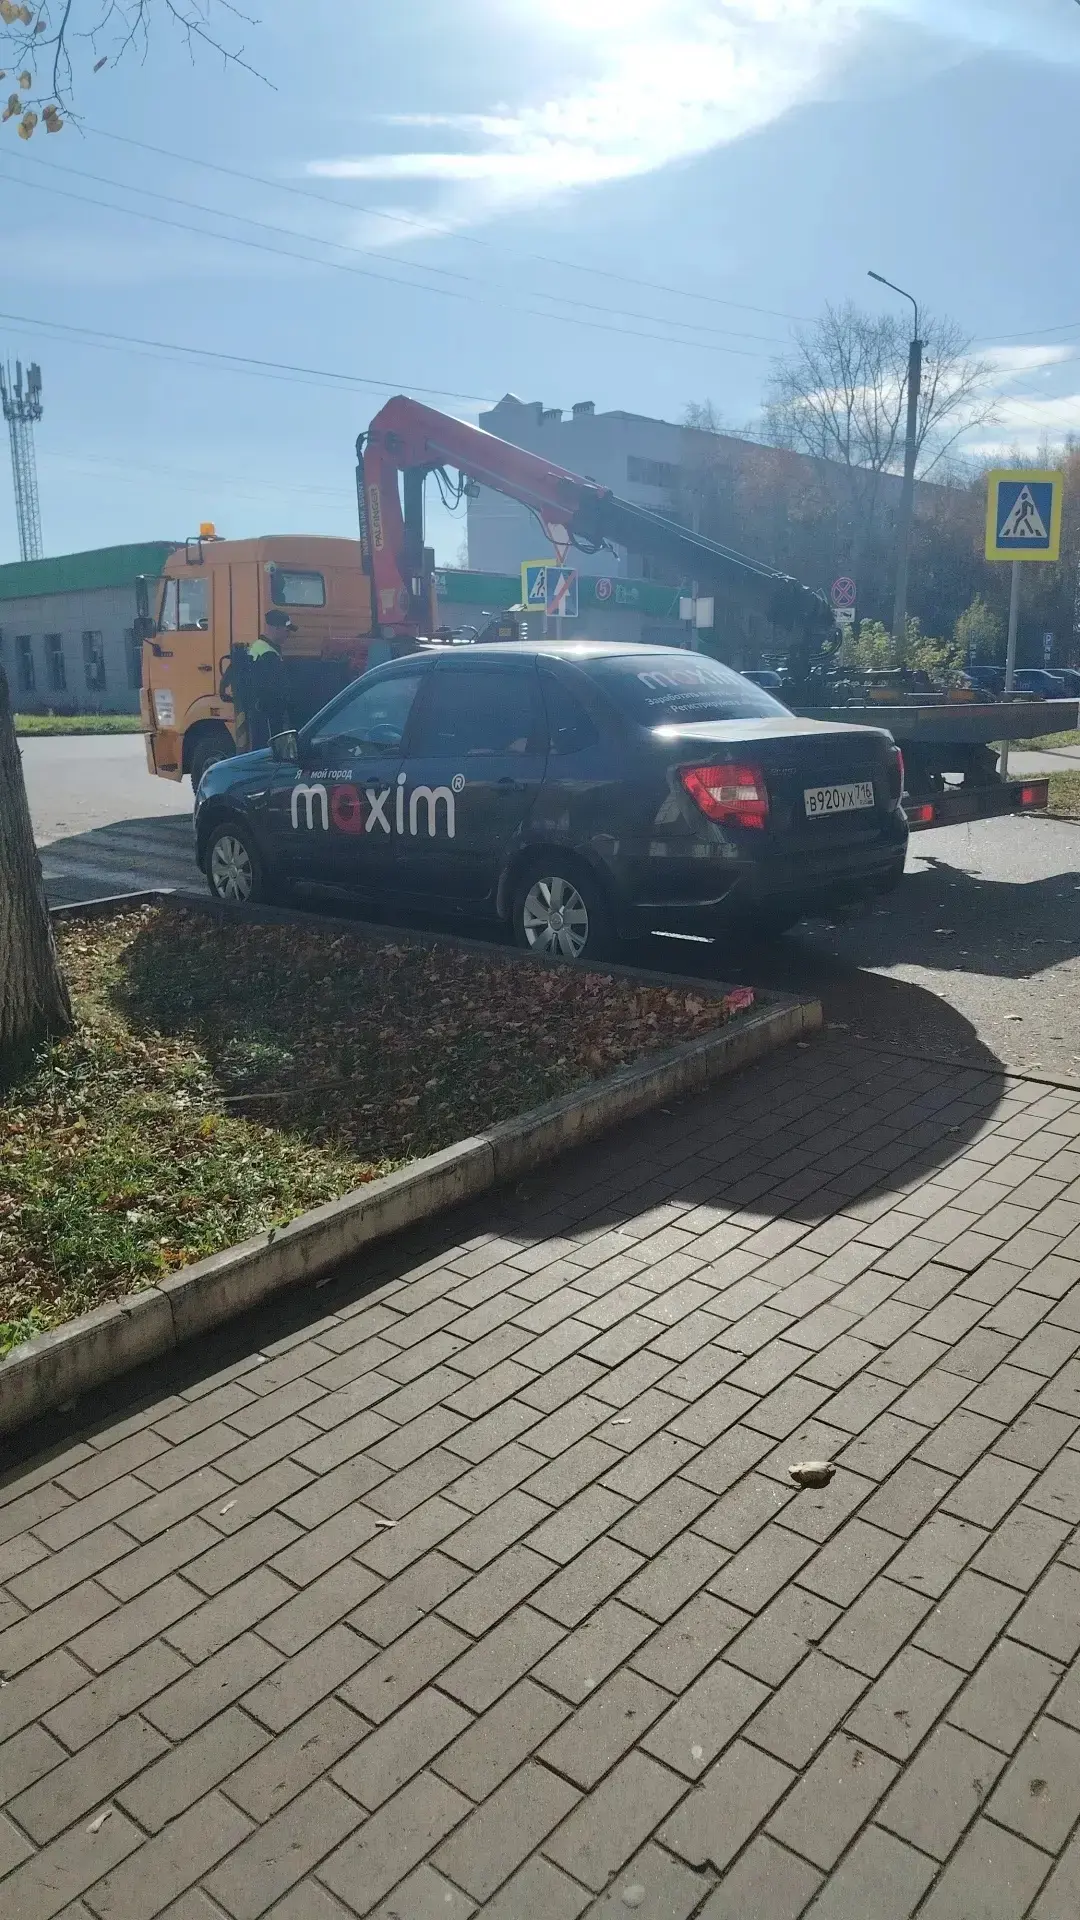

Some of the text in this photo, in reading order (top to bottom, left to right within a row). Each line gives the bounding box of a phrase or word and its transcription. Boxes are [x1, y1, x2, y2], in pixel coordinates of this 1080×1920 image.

[371, 488, 382, 547] PALFINGER
[295, 768, 352, 780] Я мой город
[855, 783, 872, 799] 716
